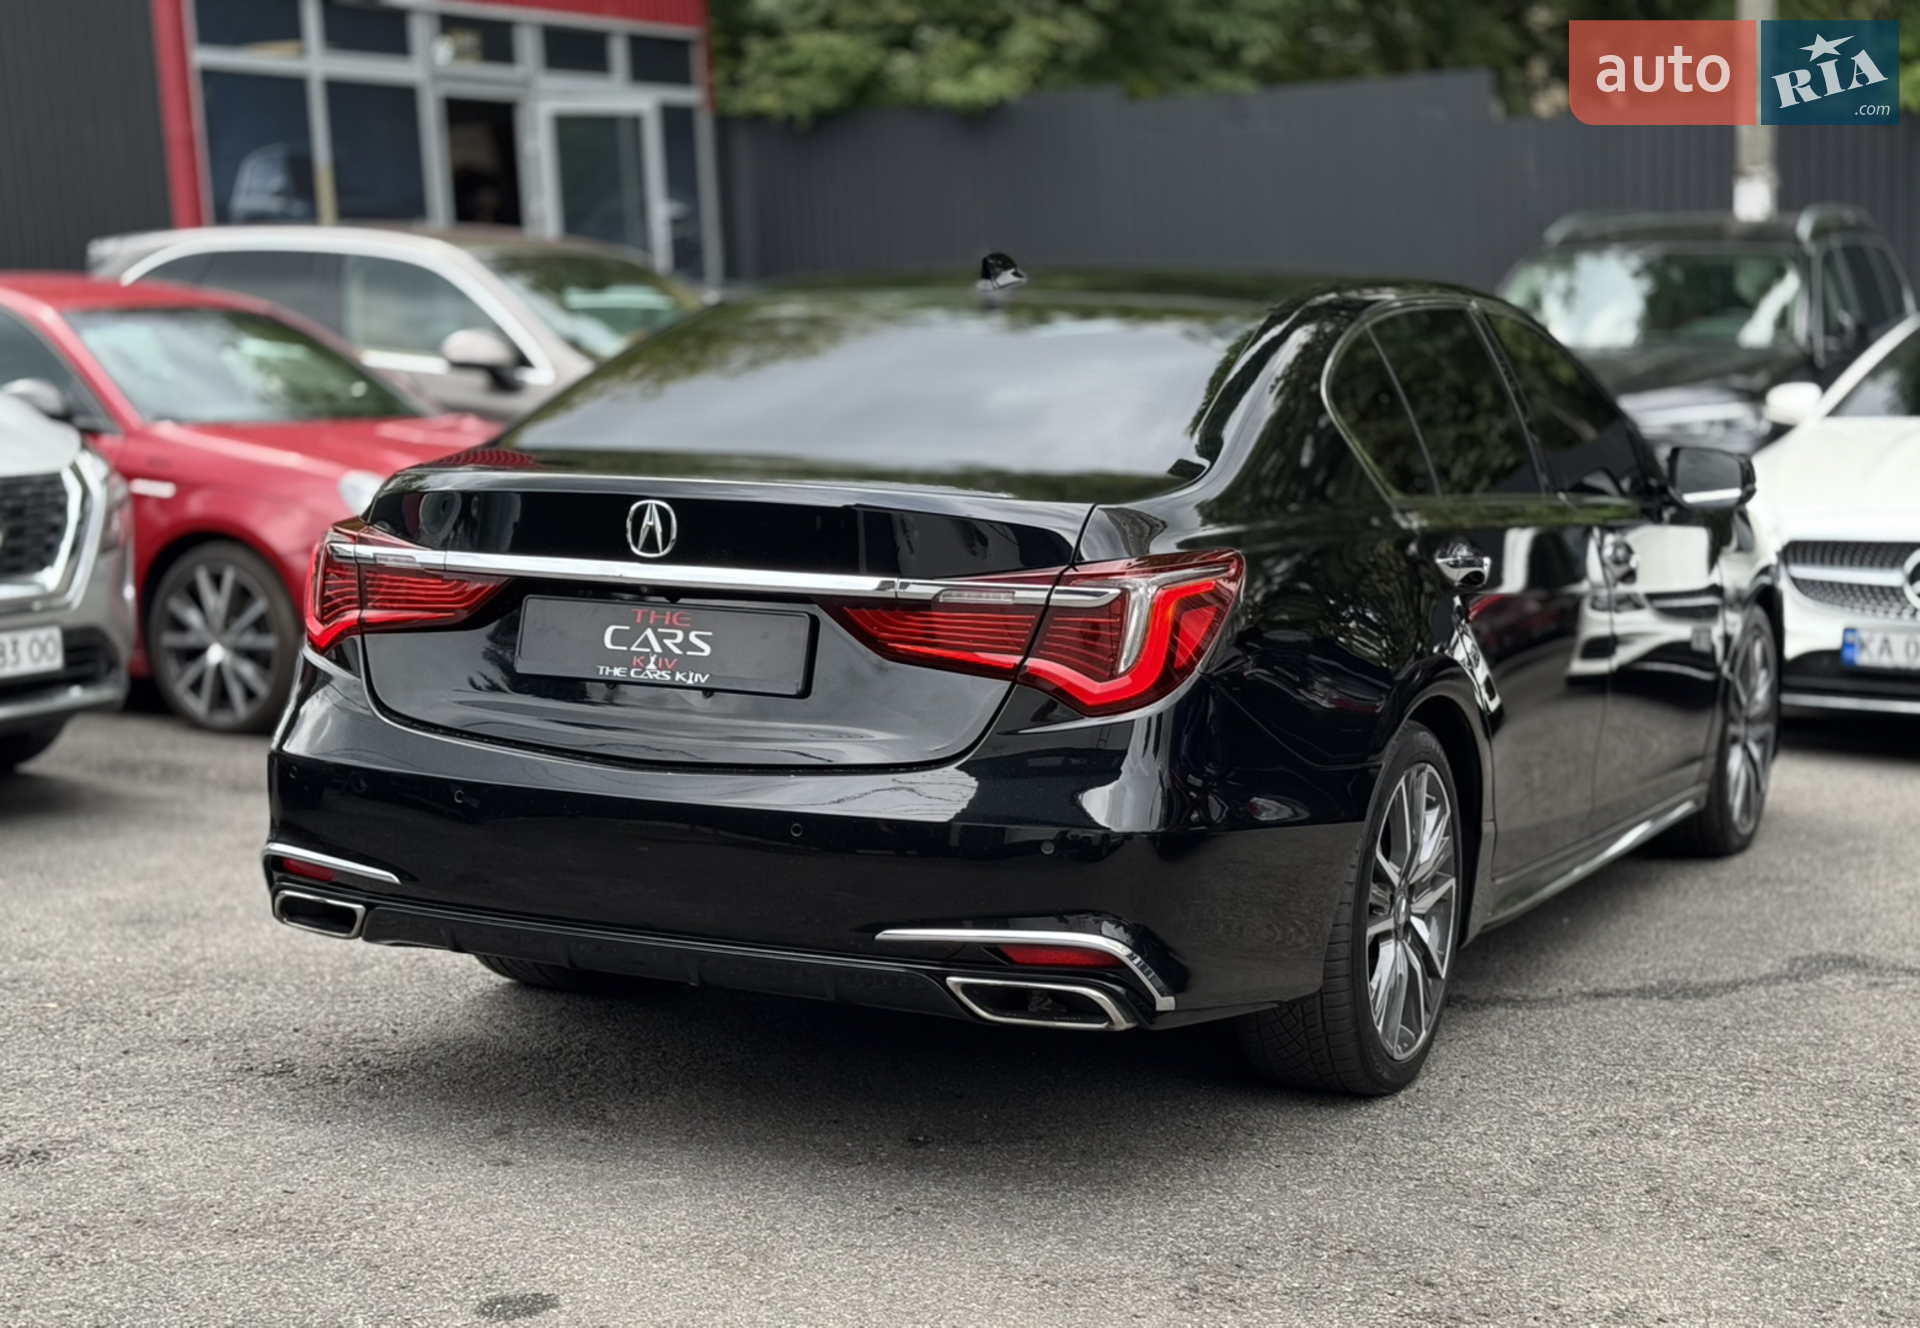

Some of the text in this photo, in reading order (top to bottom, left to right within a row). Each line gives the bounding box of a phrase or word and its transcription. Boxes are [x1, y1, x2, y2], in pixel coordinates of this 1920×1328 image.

[631, 608, 693, 627] THE
[603, 625, 713, 656] CARS
[596, 665, 628, 677] THE
[630, 668, 672, 680] CARS
